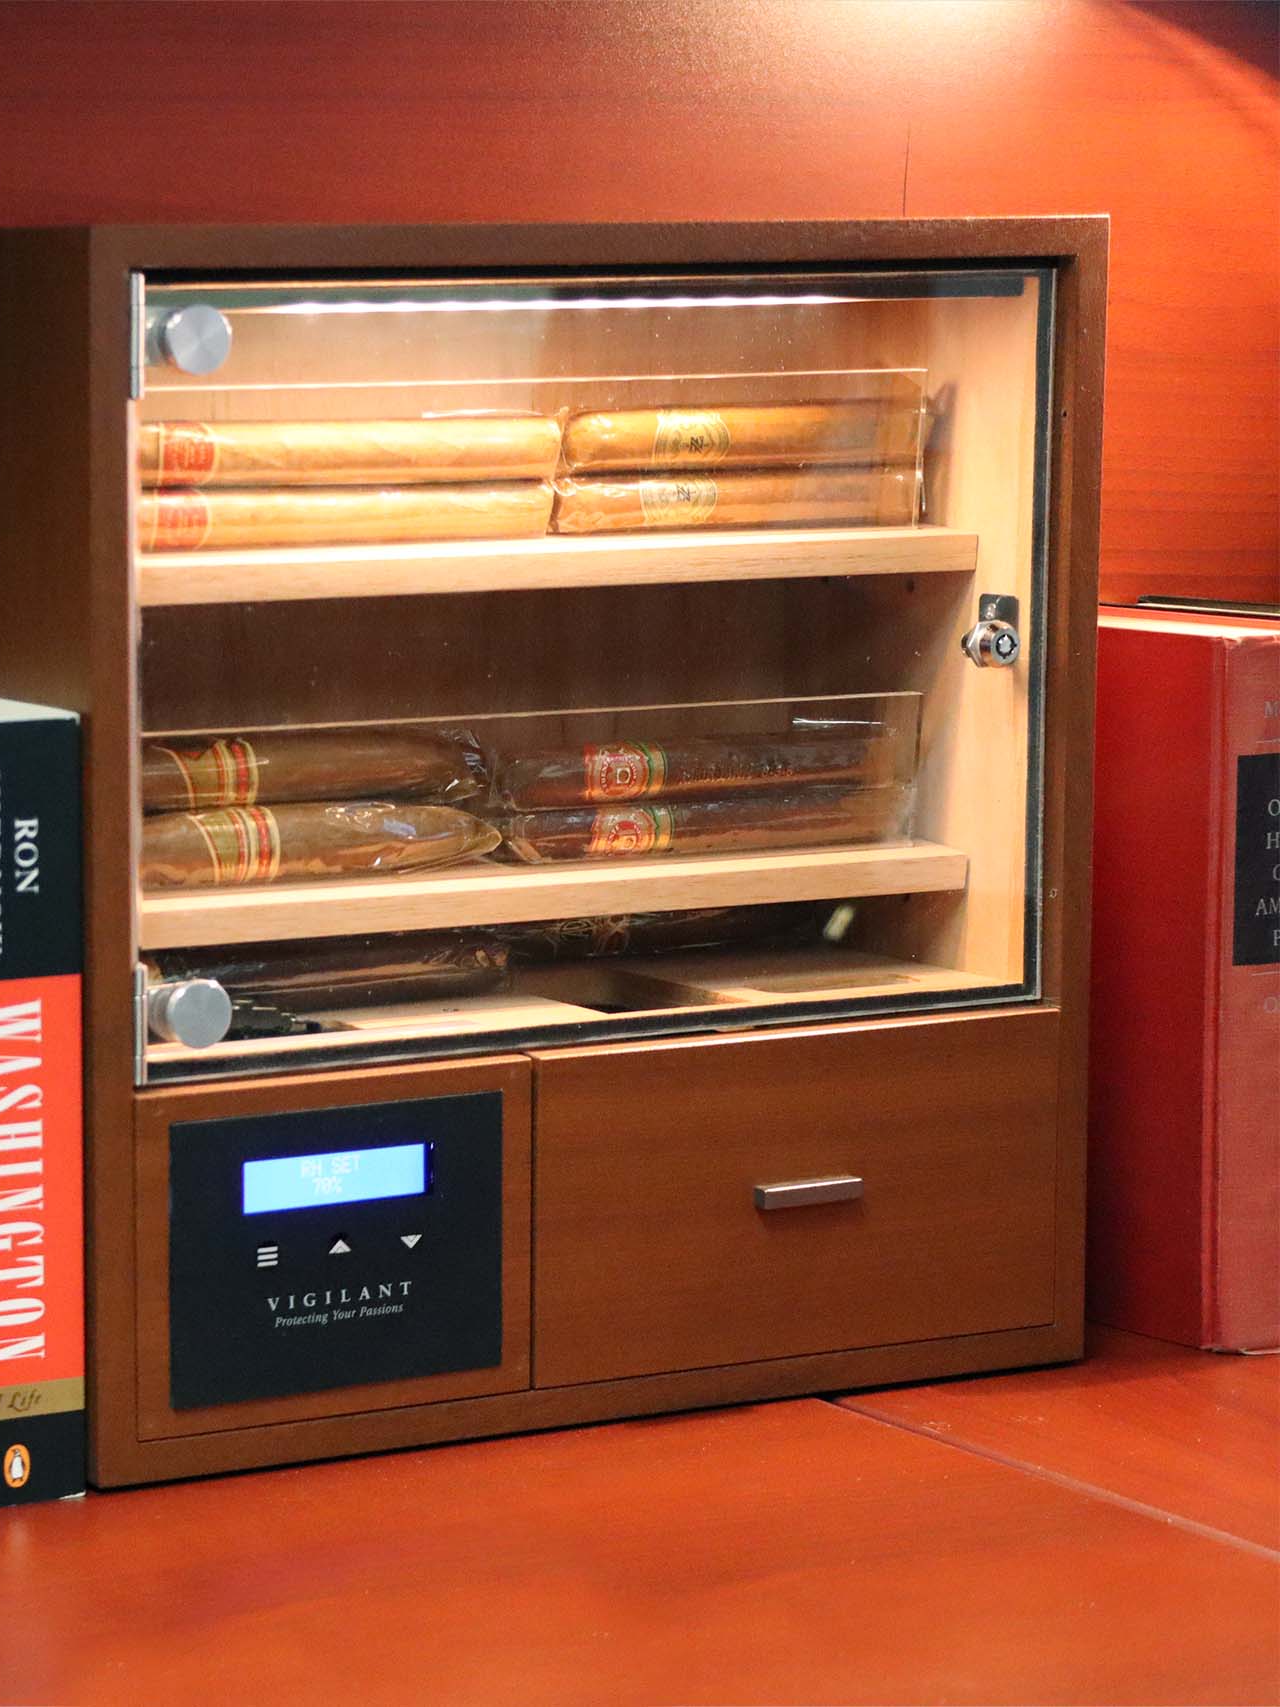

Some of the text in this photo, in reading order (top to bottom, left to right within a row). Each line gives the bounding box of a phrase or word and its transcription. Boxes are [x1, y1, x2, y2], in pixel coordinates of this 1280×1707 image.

[14, 817, 40, 894] RON
[331, 1152, 361, 1175] SET
[267, 1281, 413, 1312] VIGILANT
[274, 1302, 404, 1329] Protecting Your Passions
